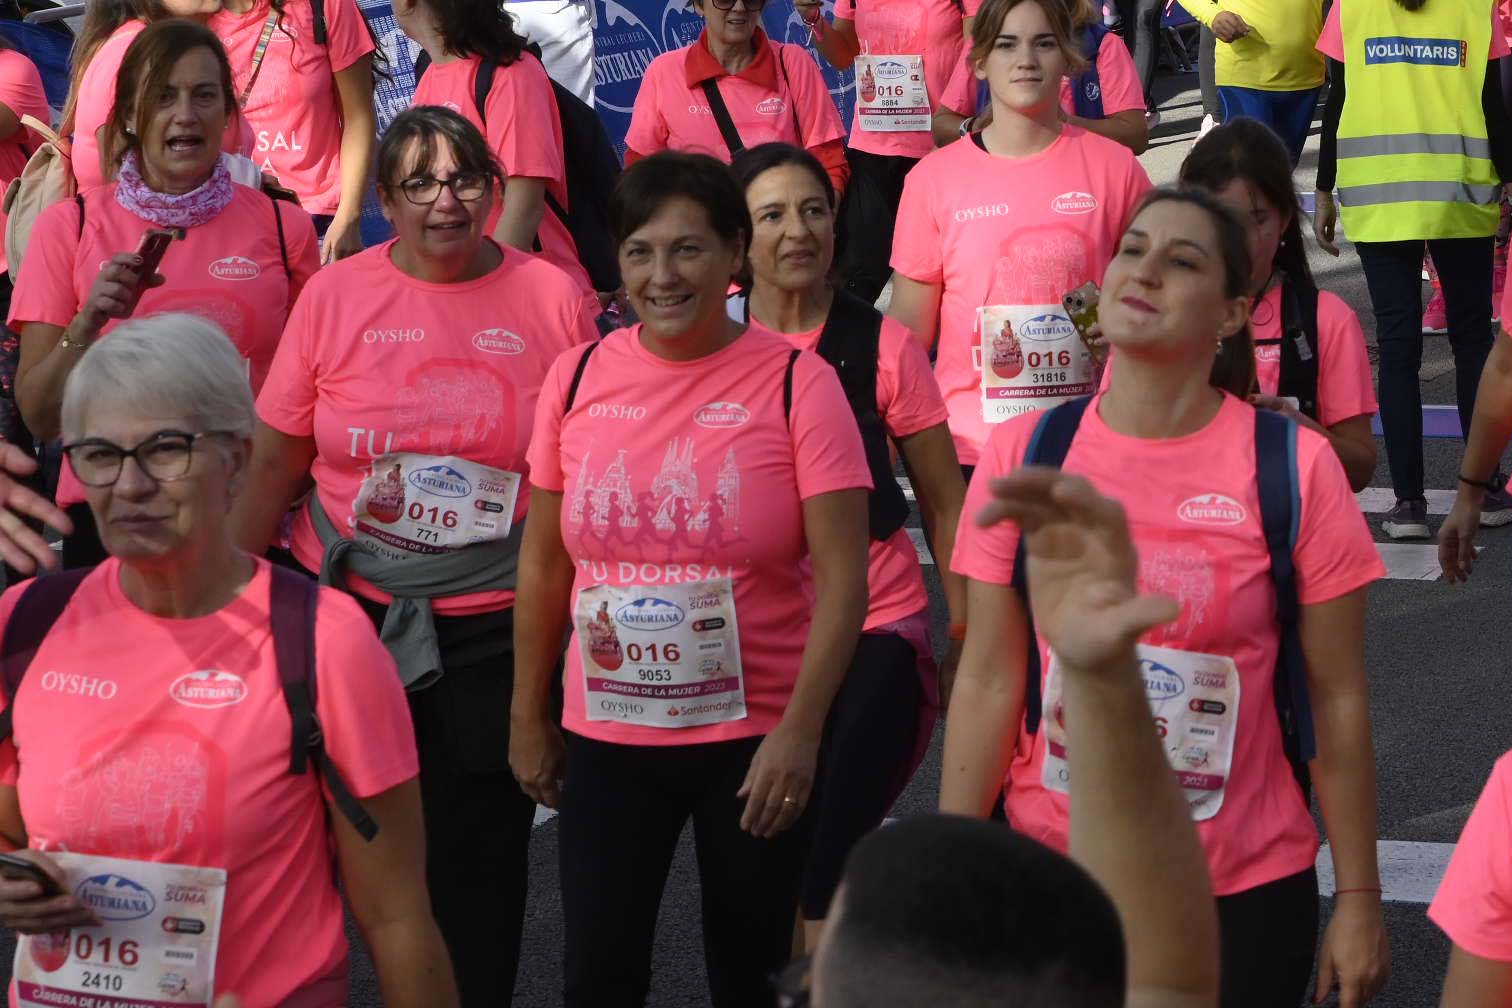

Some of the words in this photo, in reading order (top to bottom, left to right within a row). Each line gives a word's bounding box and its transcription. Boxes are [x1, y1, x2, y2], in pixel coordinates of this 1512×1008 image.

[1366, 41, 1457, 60] VOLUNTARIS
[877, 85, 904, 97] 016
[954, 203, 1009, 223] OYSHO
[363, 328, 425, 344] OYSHO
[1024, 324, 1072, 336] ASTURIANA
[1027, 350, 1071, 368] 016
[1032, 371, 1067, 384] 31816
[999, 389, 1035, 397] CARRERA
[1048, 387, 1059, 395] LA
[588, 402, 646, 421] OYSHO
[347, 427, 394, 458] TU
[412, 472, 468, 496] ASTURIANA
[477, 483, 506, 495] SUMA
[407, 502, 459, 529] 016
[1182, 504, 1244, 521] ASTURIANA
[416, 527, 439, 543] 771
[409, 542, 421, 552] DE
[689, 597, 721, 611] SUMA
[622, 609, 680, 624] ASTURIANA
[626, 643, 681, 662] 016
[638, 668, 672, 682] 9053
[1192, 676, 1227, 689] SUMA
[40, 669, 119, 702] OYSHO
[602, 681, 640, 694] CARRERA
[641, 684, 653, 695] DE
[655, 686, 667, 696] LA
[668, 685, 700, 696] MUJER
[600, 699, 644, 714] OYSHO
[680, 700, 732, 717] Santander
[164, 892, 207, 905] SUMA
[75, 933, 141, 967] 016
[81, 970, 123, 992] 2410
[80, 995, 95, 1008] DE
